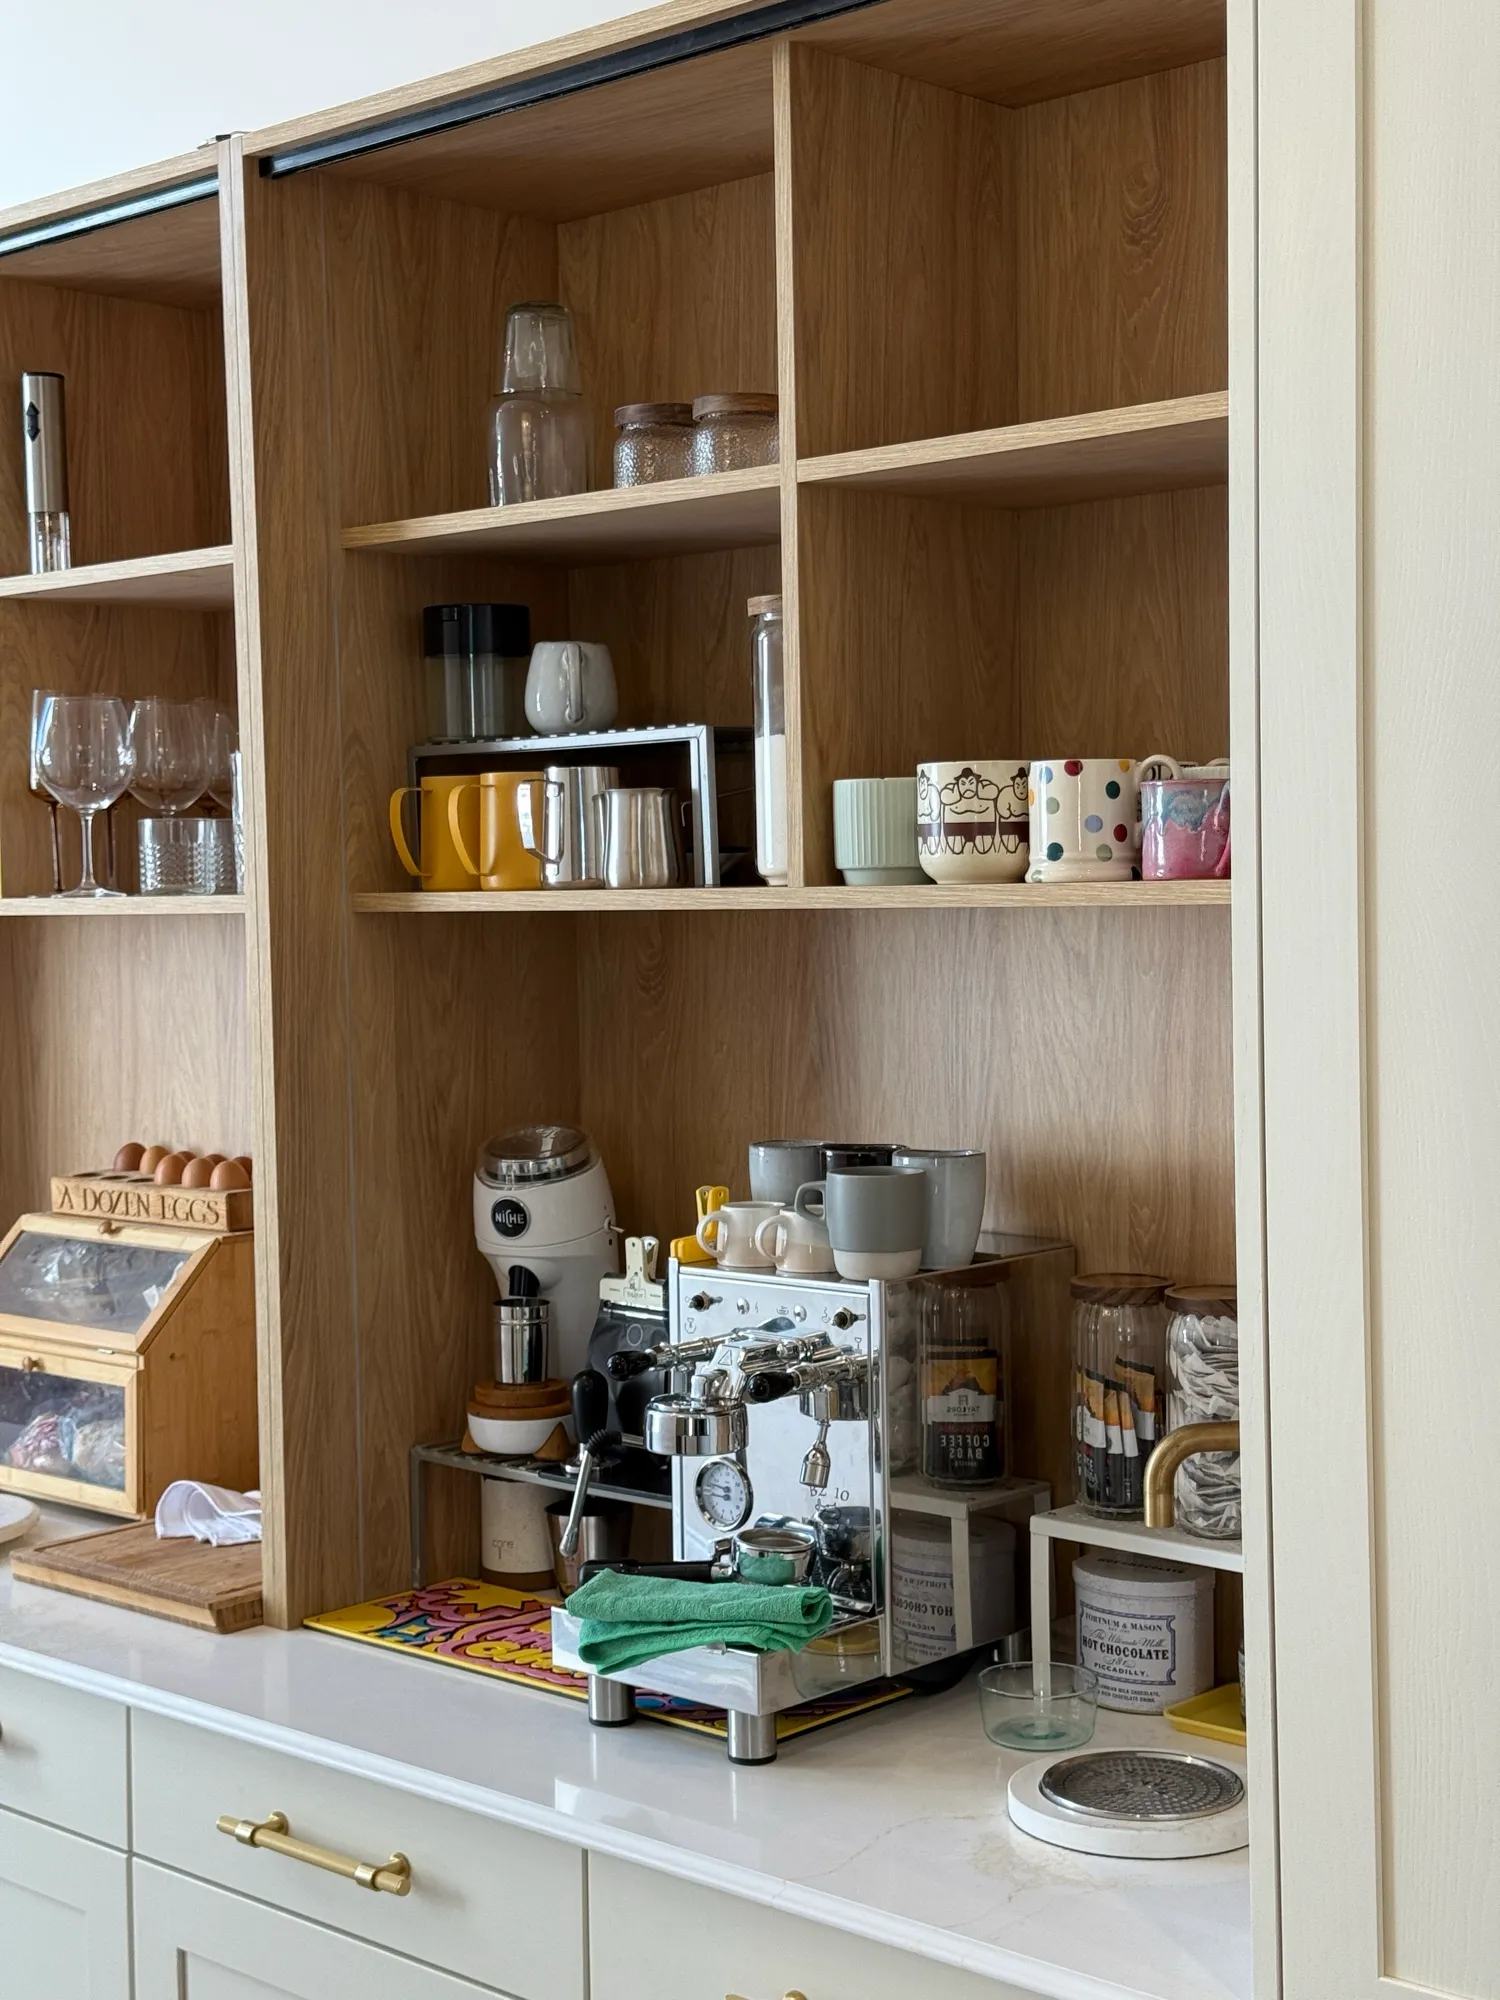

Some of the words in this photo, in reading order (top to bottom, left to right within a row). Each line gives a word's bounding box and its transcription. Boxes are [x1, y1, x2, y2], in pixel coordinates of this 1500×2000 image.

[59, 1187, 74, 1210] A
[83, 1187, 150, 1218] DOZEN
[160, 1194, 220, 1226] EGGS
[834, 1487, 850, 1502] 10
[1085, 1612, 1120, 1629] FORTNUM
[1121, 1622, 1128, 1630] &
[1131, 1622, 1163, 1632] MASON
[1082, 1635, 1098, 1651] HOT
[1099, 1641, 1169, 1660] CHOCOLATE
